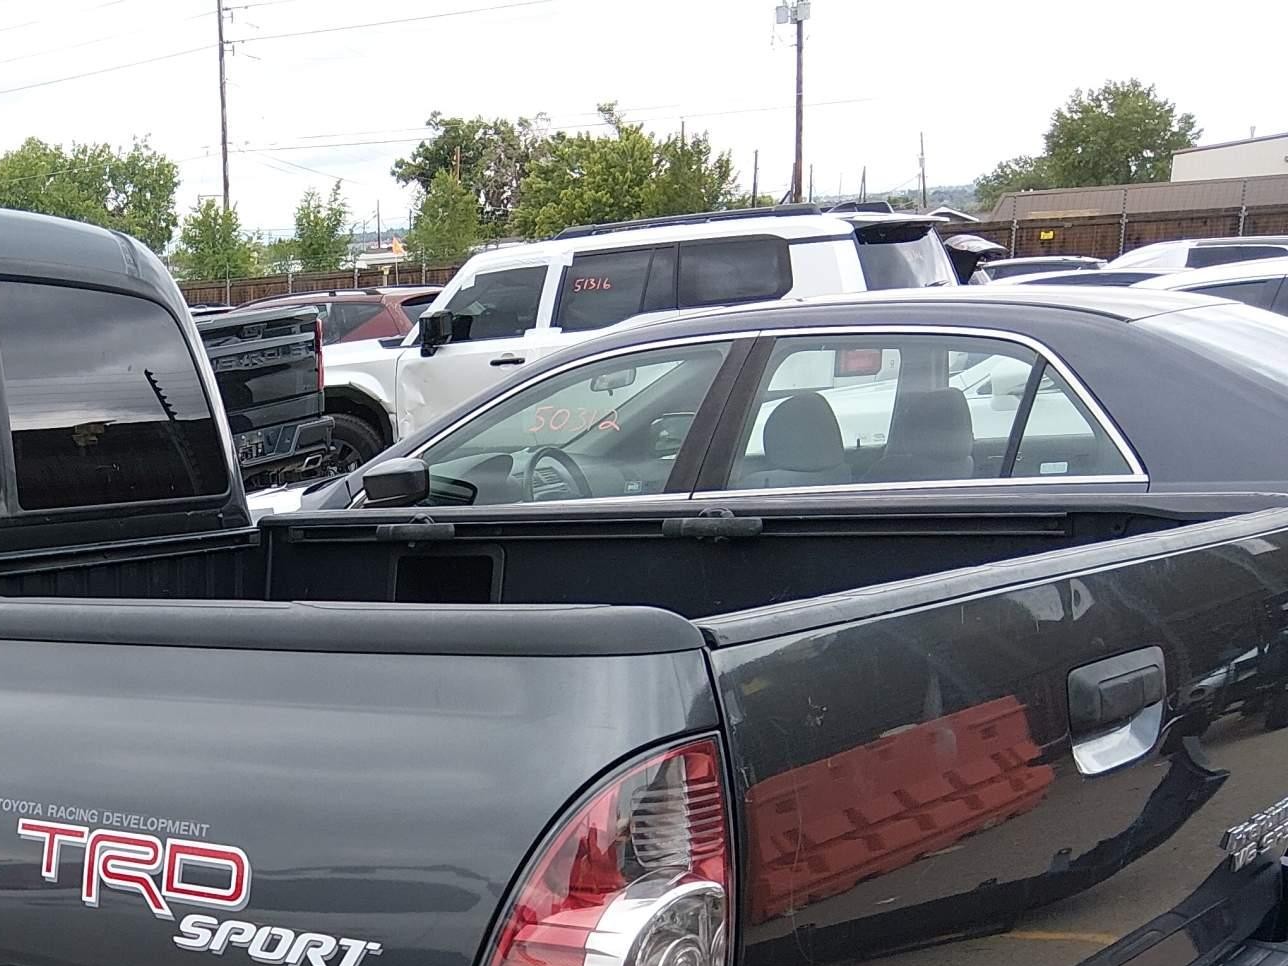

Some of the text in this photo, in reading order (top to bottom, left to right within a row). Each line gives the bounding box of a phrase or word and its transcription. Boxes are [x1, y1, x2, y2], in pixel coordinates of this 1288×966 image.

[573, 276, 611, 292] 51316
[529, 405, 620, 433] 50312
[48, 804, 99, 824] RACING
[102, 810, 210, 838] DEVELOPMENT
[16, 818, 252, 921] TRD
